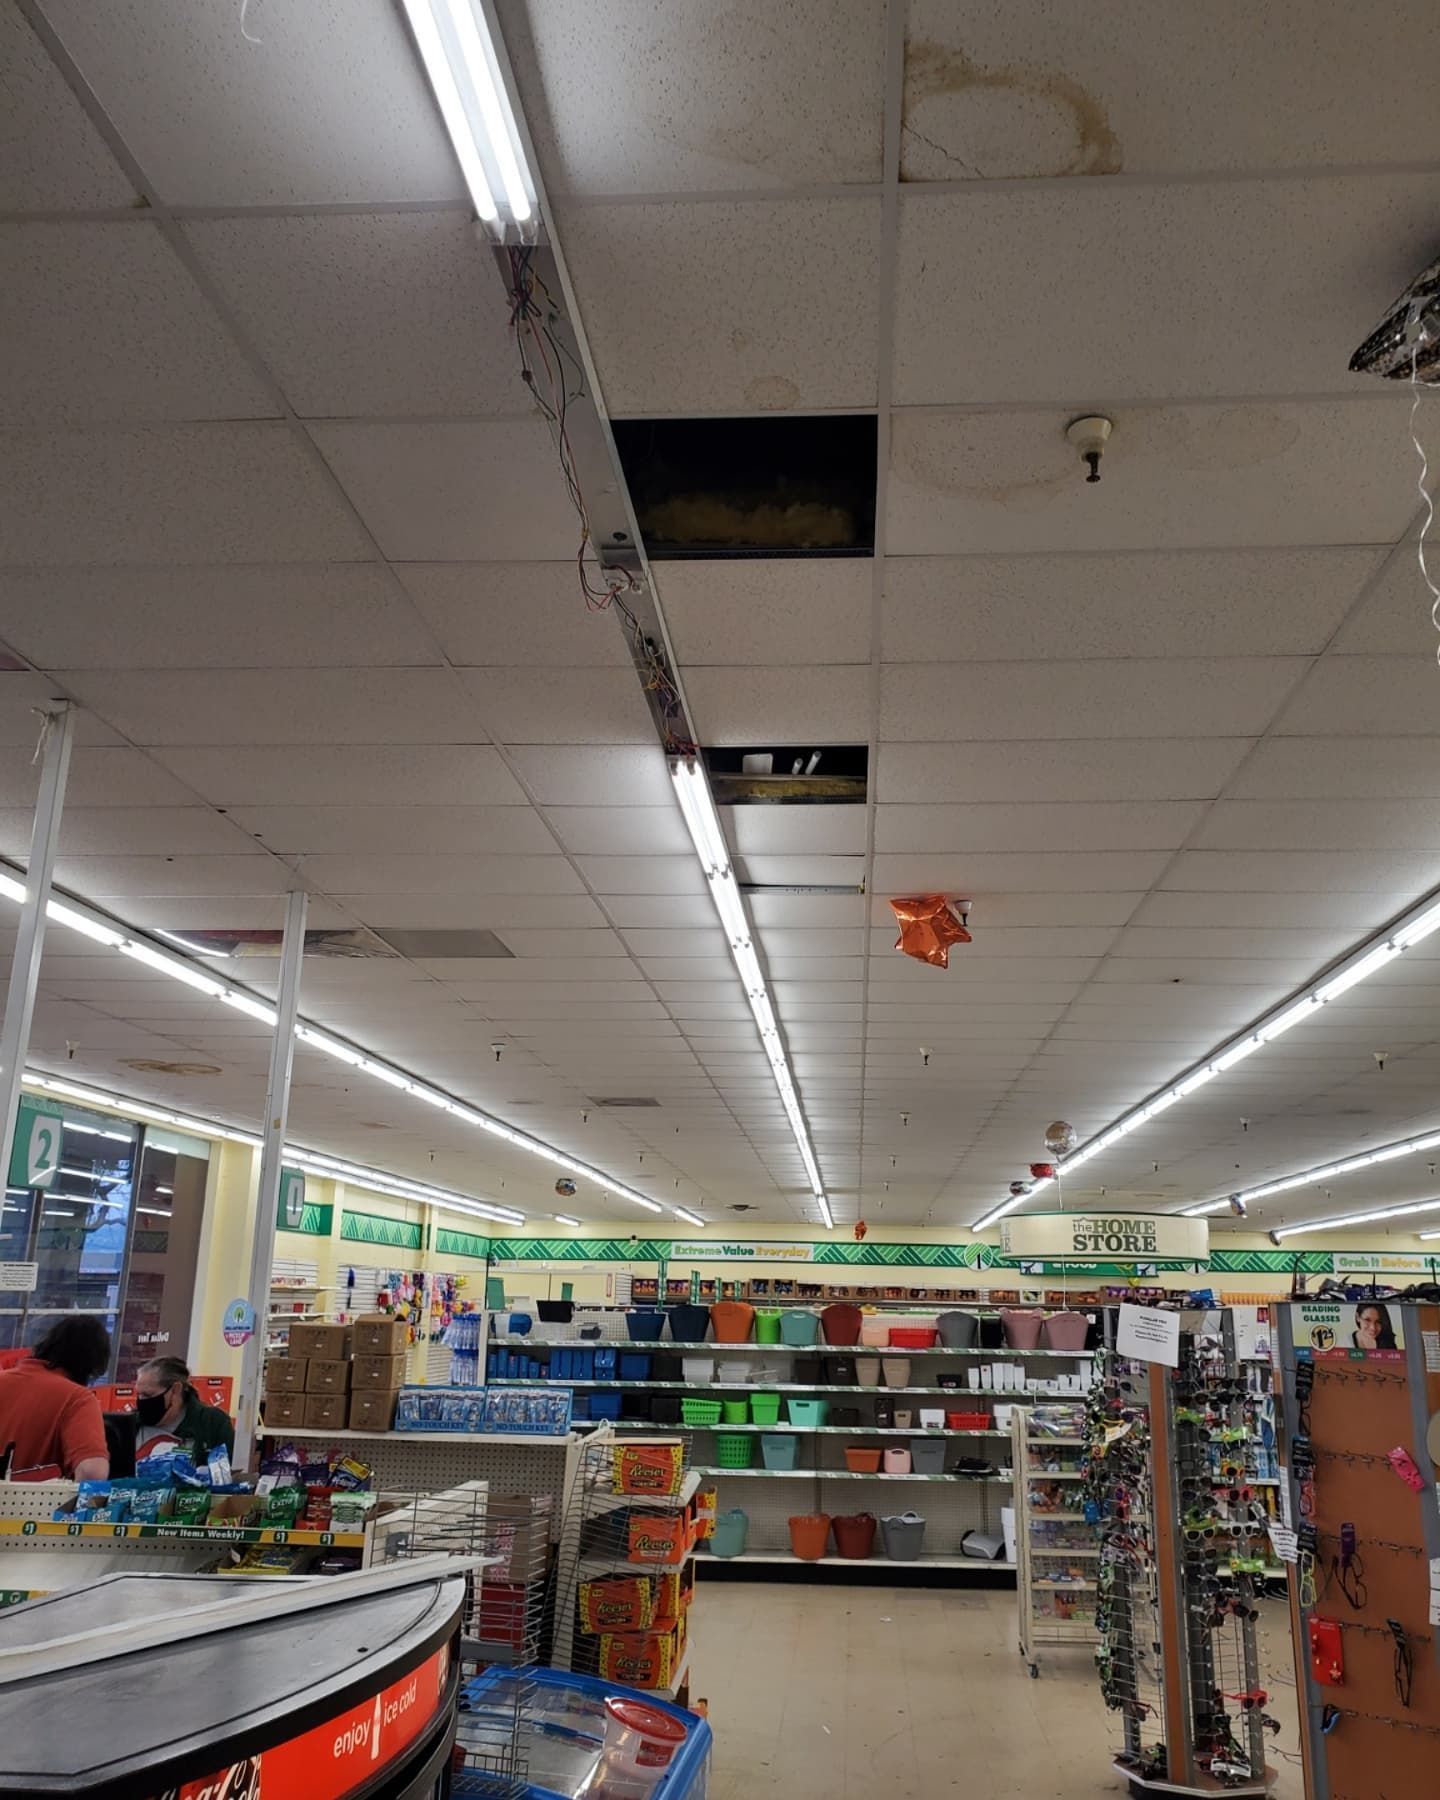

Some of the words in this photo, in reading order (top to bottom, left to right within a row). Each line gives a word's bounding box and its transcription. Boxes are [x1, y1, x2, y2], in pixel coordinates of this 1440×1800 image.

[34, 1128, 52, 1169] 2
[1073, 1221, 1093, 1233] the
[1093, 1219, 1156, 1235] HOME
[1073, 1235, 1156, 1252] STORE
[674, 1245, 721, 1256] Extreme
[722, 1244, 754, 1256] Value
[755, 1246, 810, 1258] Everyday
[1339, 1256, 1369, 1268] Grab
[1381, 1257, 1421, 1268] Before
[1301, 1305, 1340, 1313] READING
[1303, 1315, 1341, 1323] GLASSES
[25, 1523, 34, 1535] $1
[70, 1524, 80, 1536] $1
[116, 1525, 126, 1537] $1
[156, 1528, 179, 1537] New
[180, 1528, 205, 1538] Items
[207, 1529, 245, 1541] Weekly!
[276, 1531, 285, 1542] $1
[322, 1533, 332, 1546] $1
[334, 1719, 371, 1758] enjoy
[383, 1700, 398, 1727] ice
[399, 1678, 417, 1714] cold
